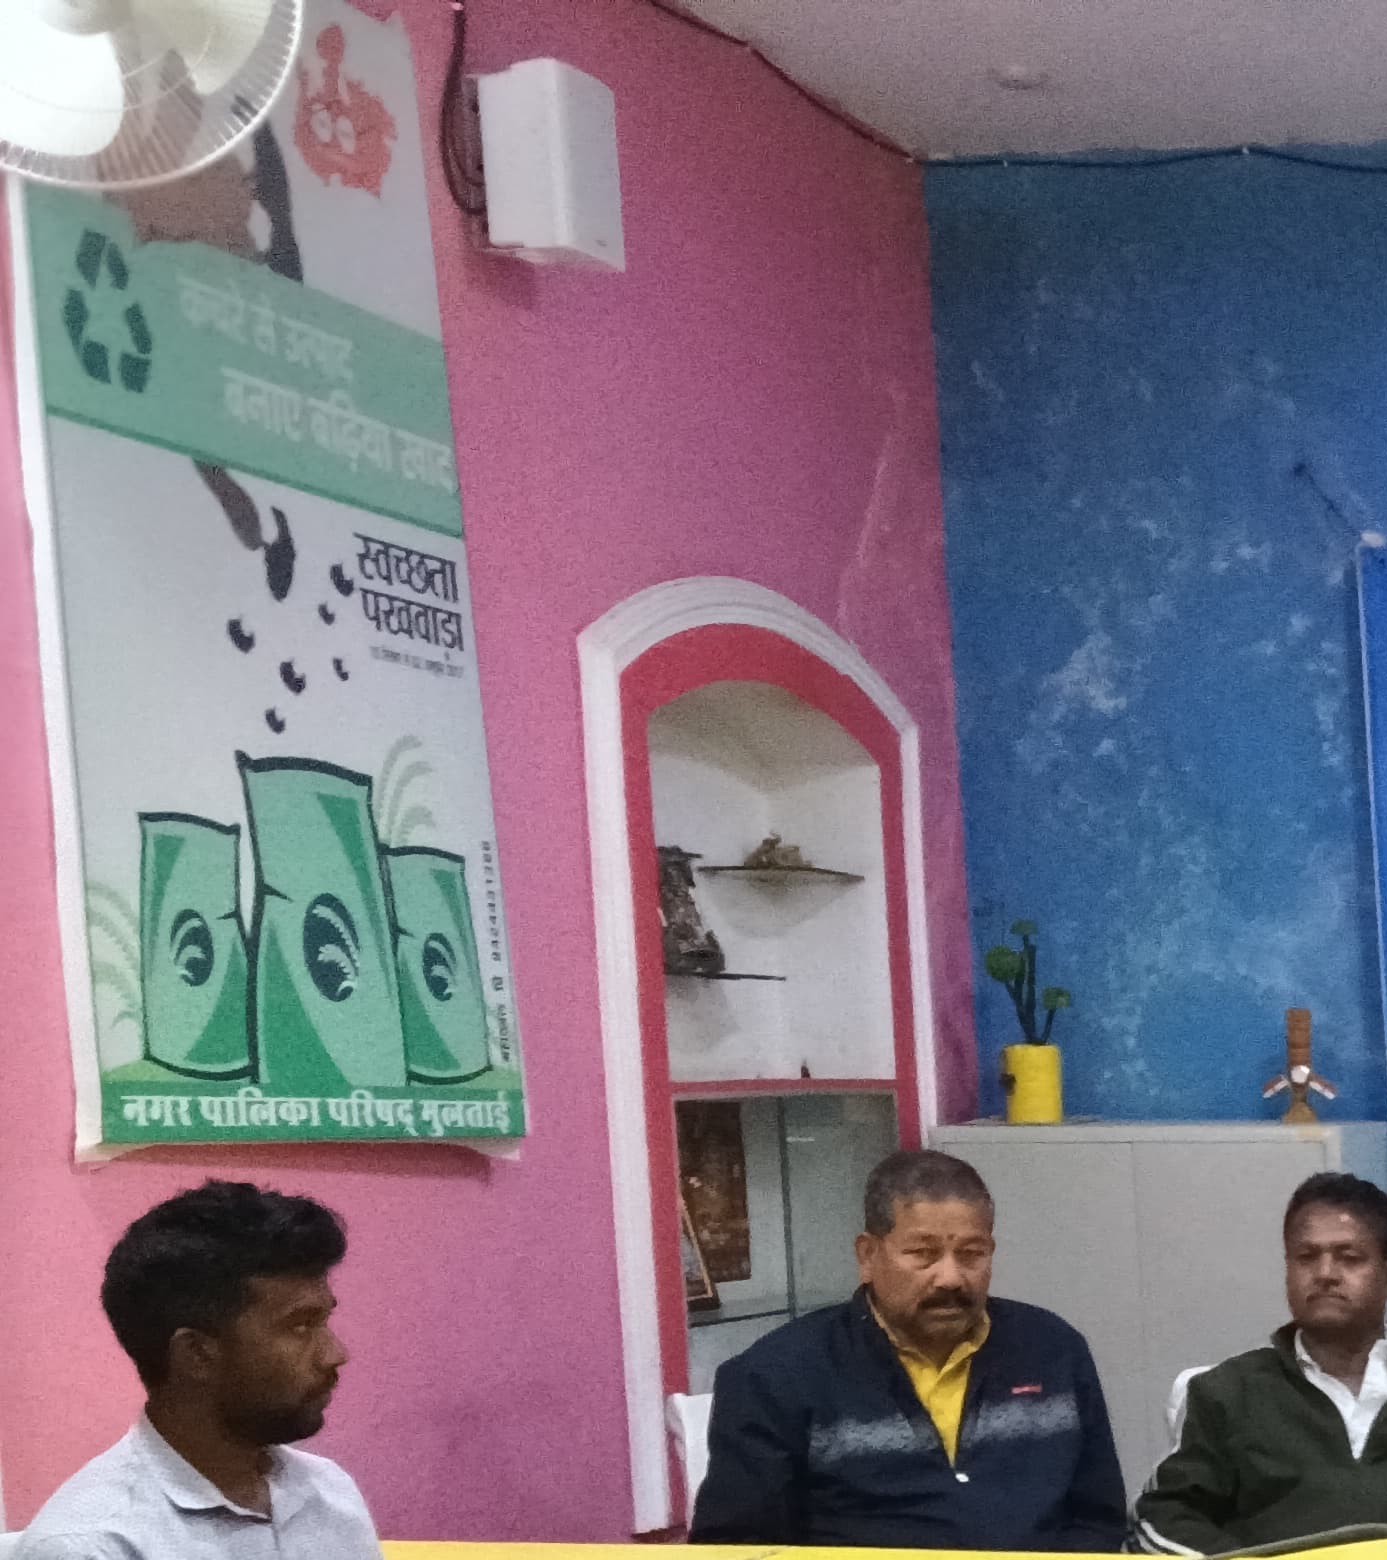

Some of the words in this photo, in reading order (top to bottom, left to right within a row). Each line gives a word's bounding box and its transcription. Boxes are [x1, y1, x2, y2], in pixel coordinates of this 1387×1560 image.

[353, 532, 460, 603] स्वच्छता
[120, 1094, 194, 1127] नगर
[199, 1085, 321, 1128] पालिका
[420, 1089, 513, 1137] मुलताई
